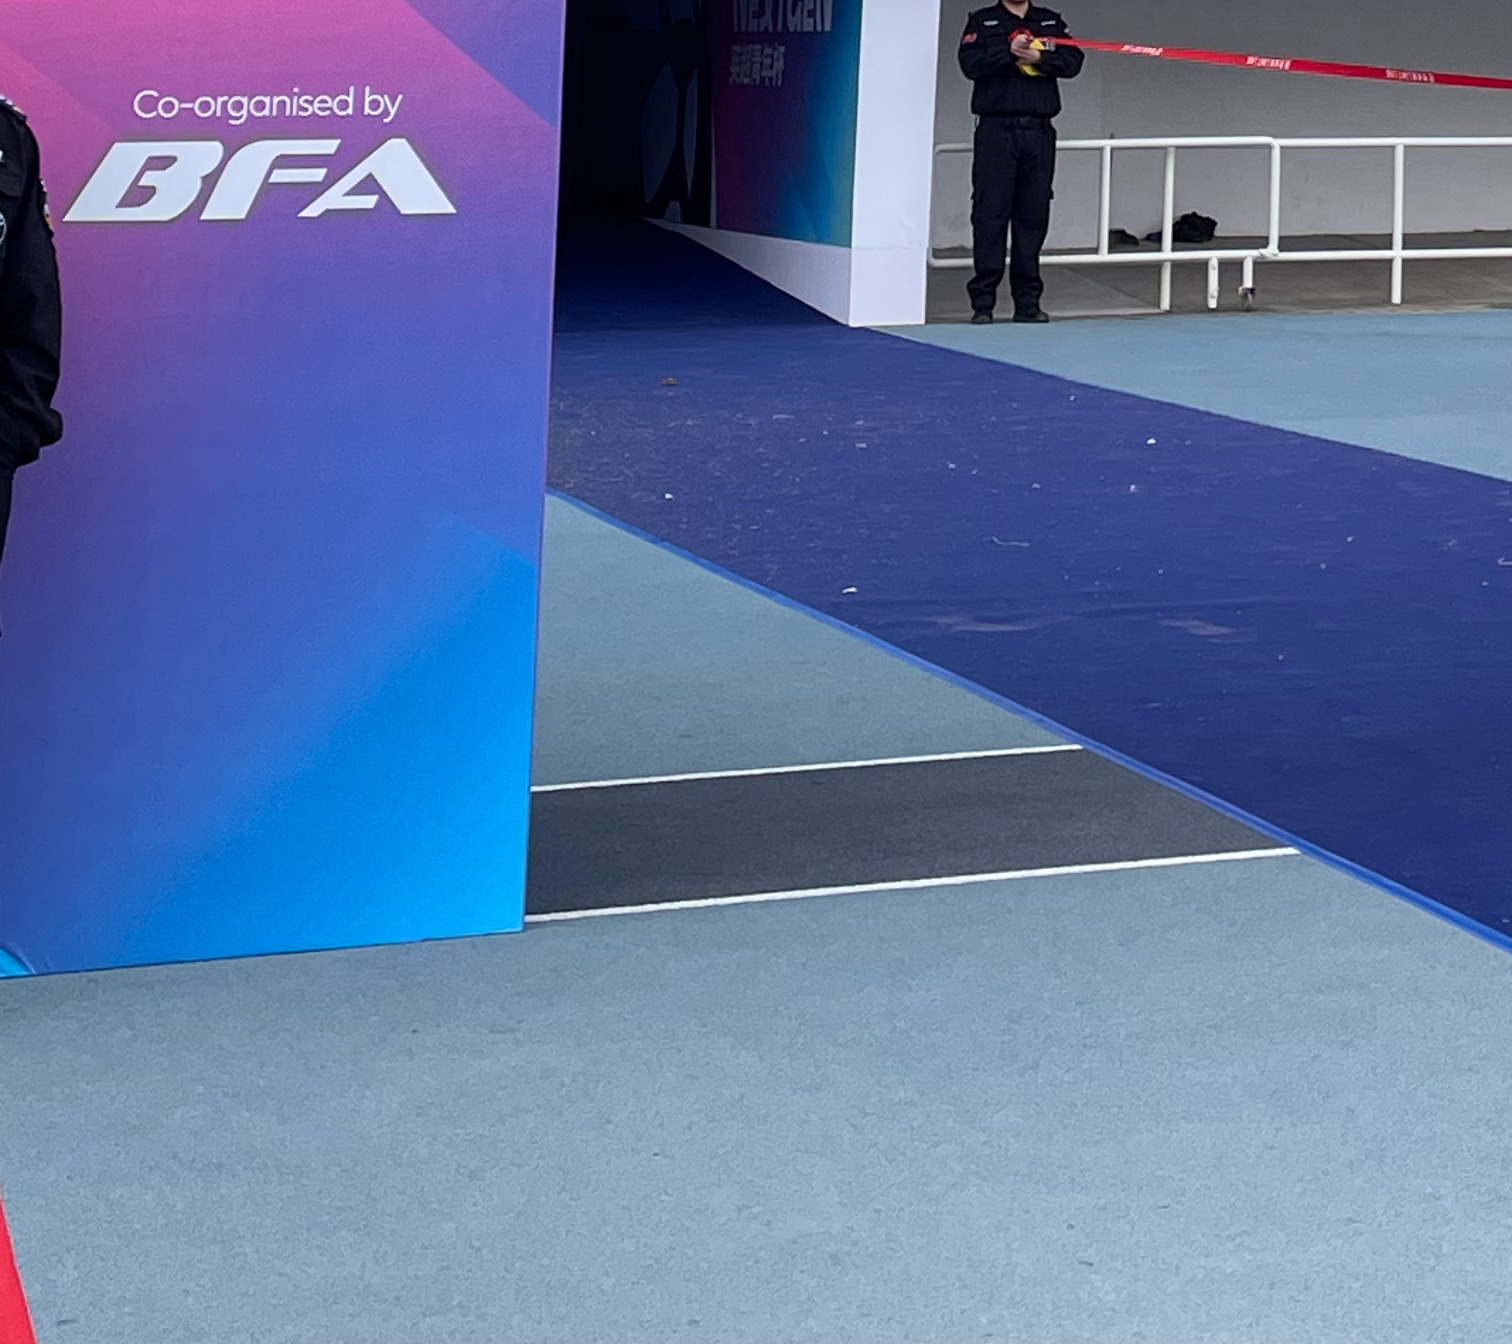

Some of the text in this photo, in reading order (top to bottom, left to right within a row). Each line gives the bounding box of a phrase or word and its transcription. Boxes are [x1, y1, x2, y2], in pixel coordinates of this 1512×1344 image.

[133, 86, 403, 125] Co-organised by
[62, 138, 457, 221] BFA
